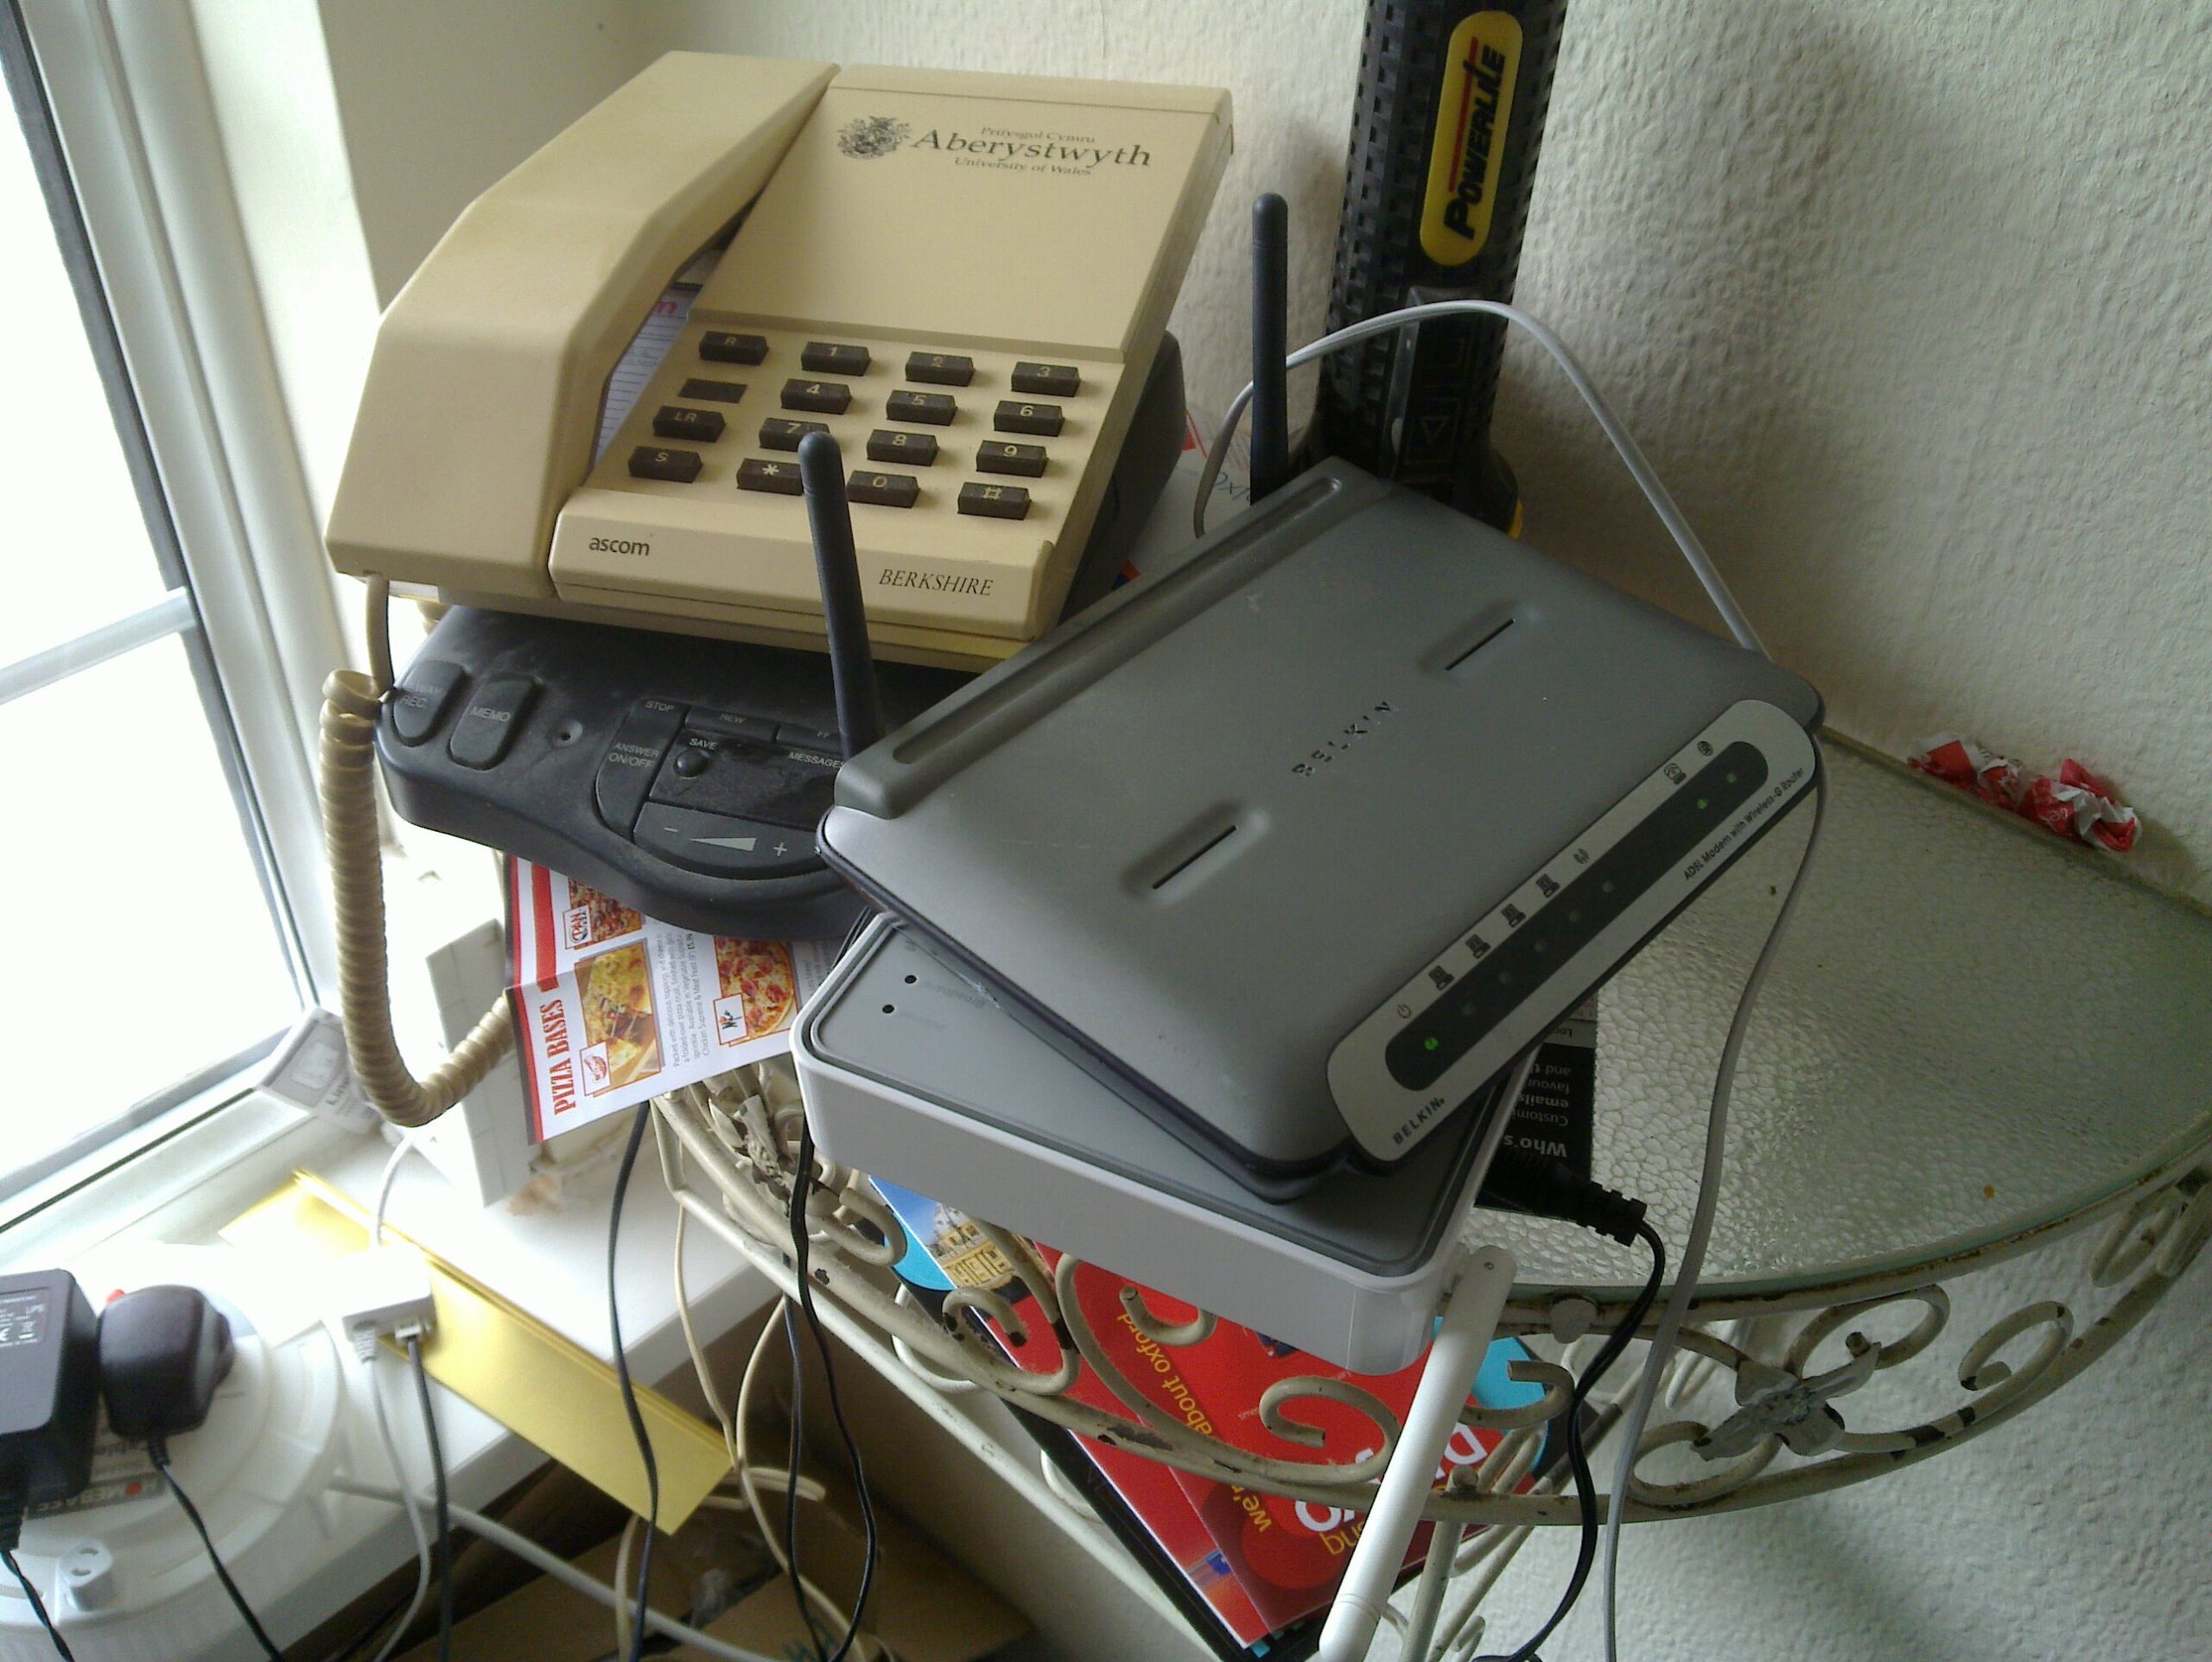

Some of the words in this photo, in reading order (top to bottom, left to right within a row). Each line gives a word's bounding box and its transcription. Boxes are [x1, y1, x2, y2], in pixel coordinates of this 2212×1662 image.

[911, 129, 1151, 168] Aberystwyth
[955, 156, 1027, 173] University
[1032, 162, 1047, 173] of
[1052, 165, 1092, 175] Wales
[829, 346, 839, 358] 1
[1037, 367, 1051, 377] 3
[805, 384, 821, 394] 4
[912, 395, 926, 406] 5
[1019, 405, 1034, 417] 6
[785, 422, 802, 434] 7
[892, 435, 906, 447] 8
[1004, 446, 1018, 457] 9
[588, 536, 651, 557] ascom
[878, 568, 994, 597] BERKSHIRE
[469, 706, 512, 722] MEMO
[645, 700, 674, 713] STOP
[613, 742, 659, 758] ANSWER
[689, 738, 718, 751] SAVE
[608, 752, 655, 769] ON/OFF
[788, 752, 847, 769] MESSAGES
[1681, 858, 1704, 880] ADSL
[1699, 832, 1732, 863] Modem
[1727, 817, 1748, 838] with
[1778, 765, 1806, 791] Router
[539, 999, 569, 1058] BASES
[1546, 1064, 1571, 1077] and
[550, 1058, 575, 1115] PIZZA
[1518, 1093, 1569, 1109] emails
[1393, 1098, 1441, 1145] BELKIN
[1503, 1134, 1567, 1158] Who's
[1161, 1375, 1213, 1436] about
